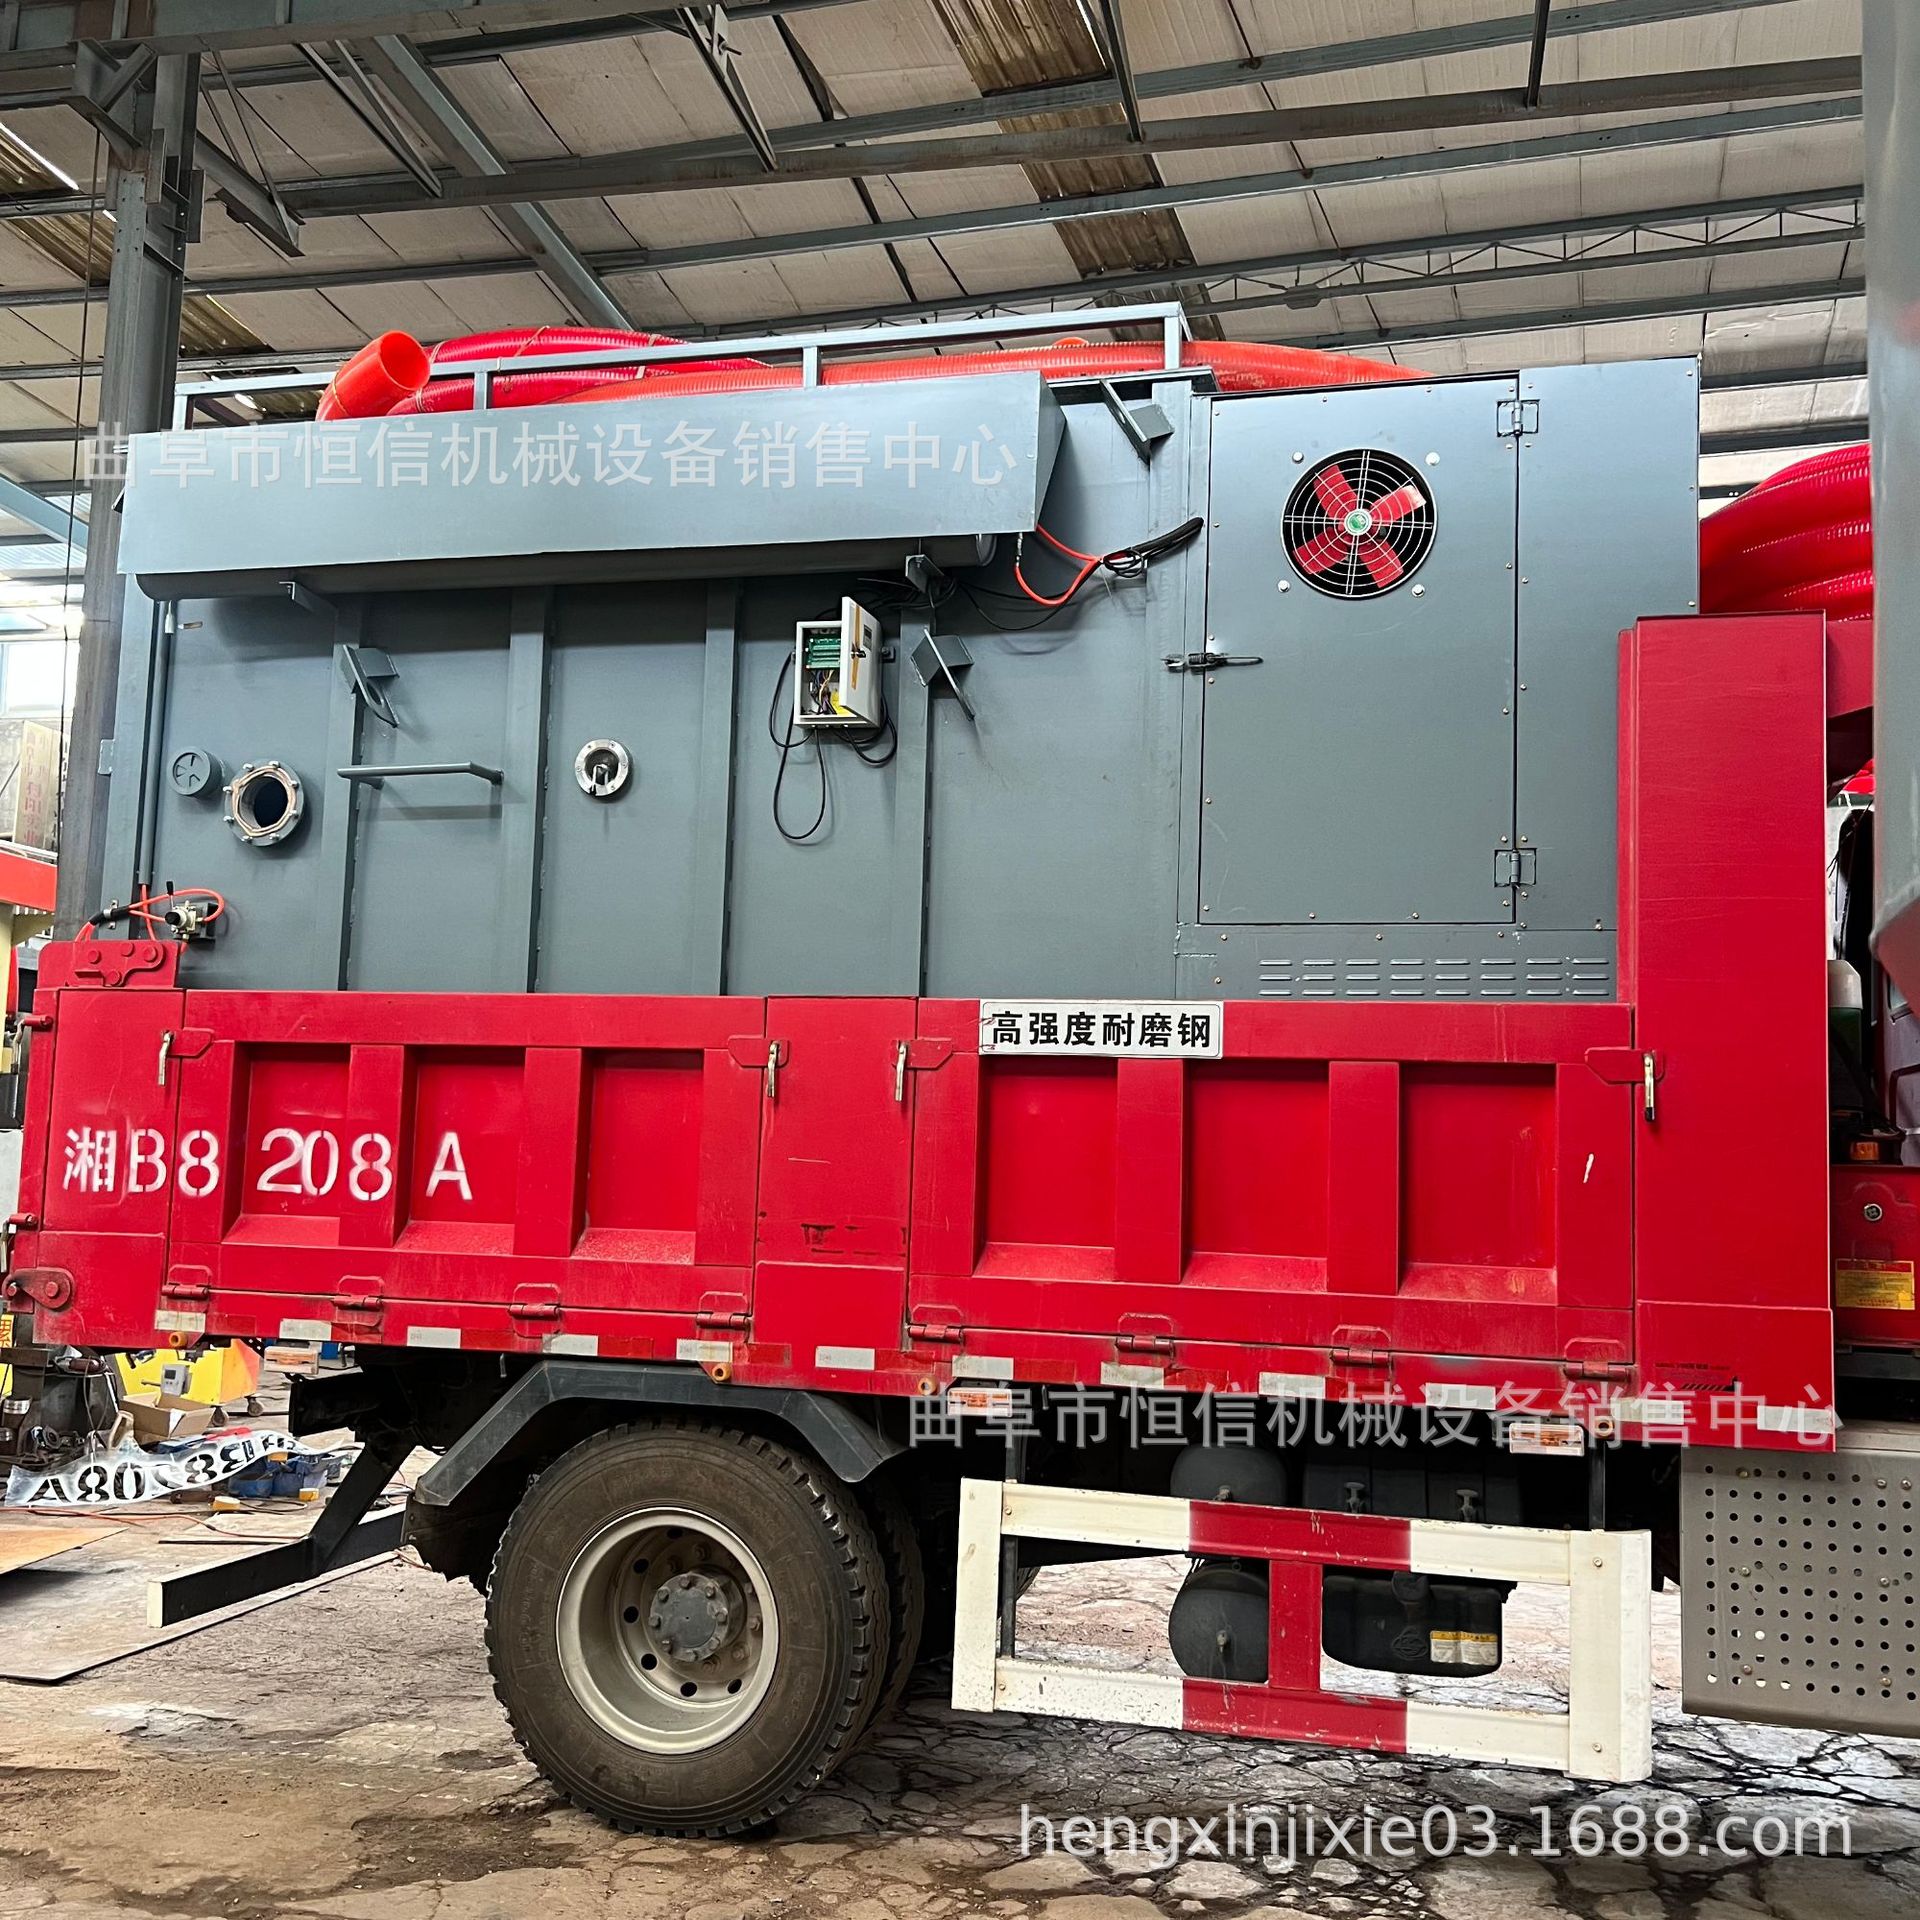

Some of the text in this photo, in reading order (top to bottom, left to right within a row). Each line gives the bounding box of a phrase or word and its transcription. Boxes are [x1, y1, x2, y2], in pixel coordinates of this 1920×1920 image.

[991, 1010, 1211, 1048] 高强度耐磨钢
